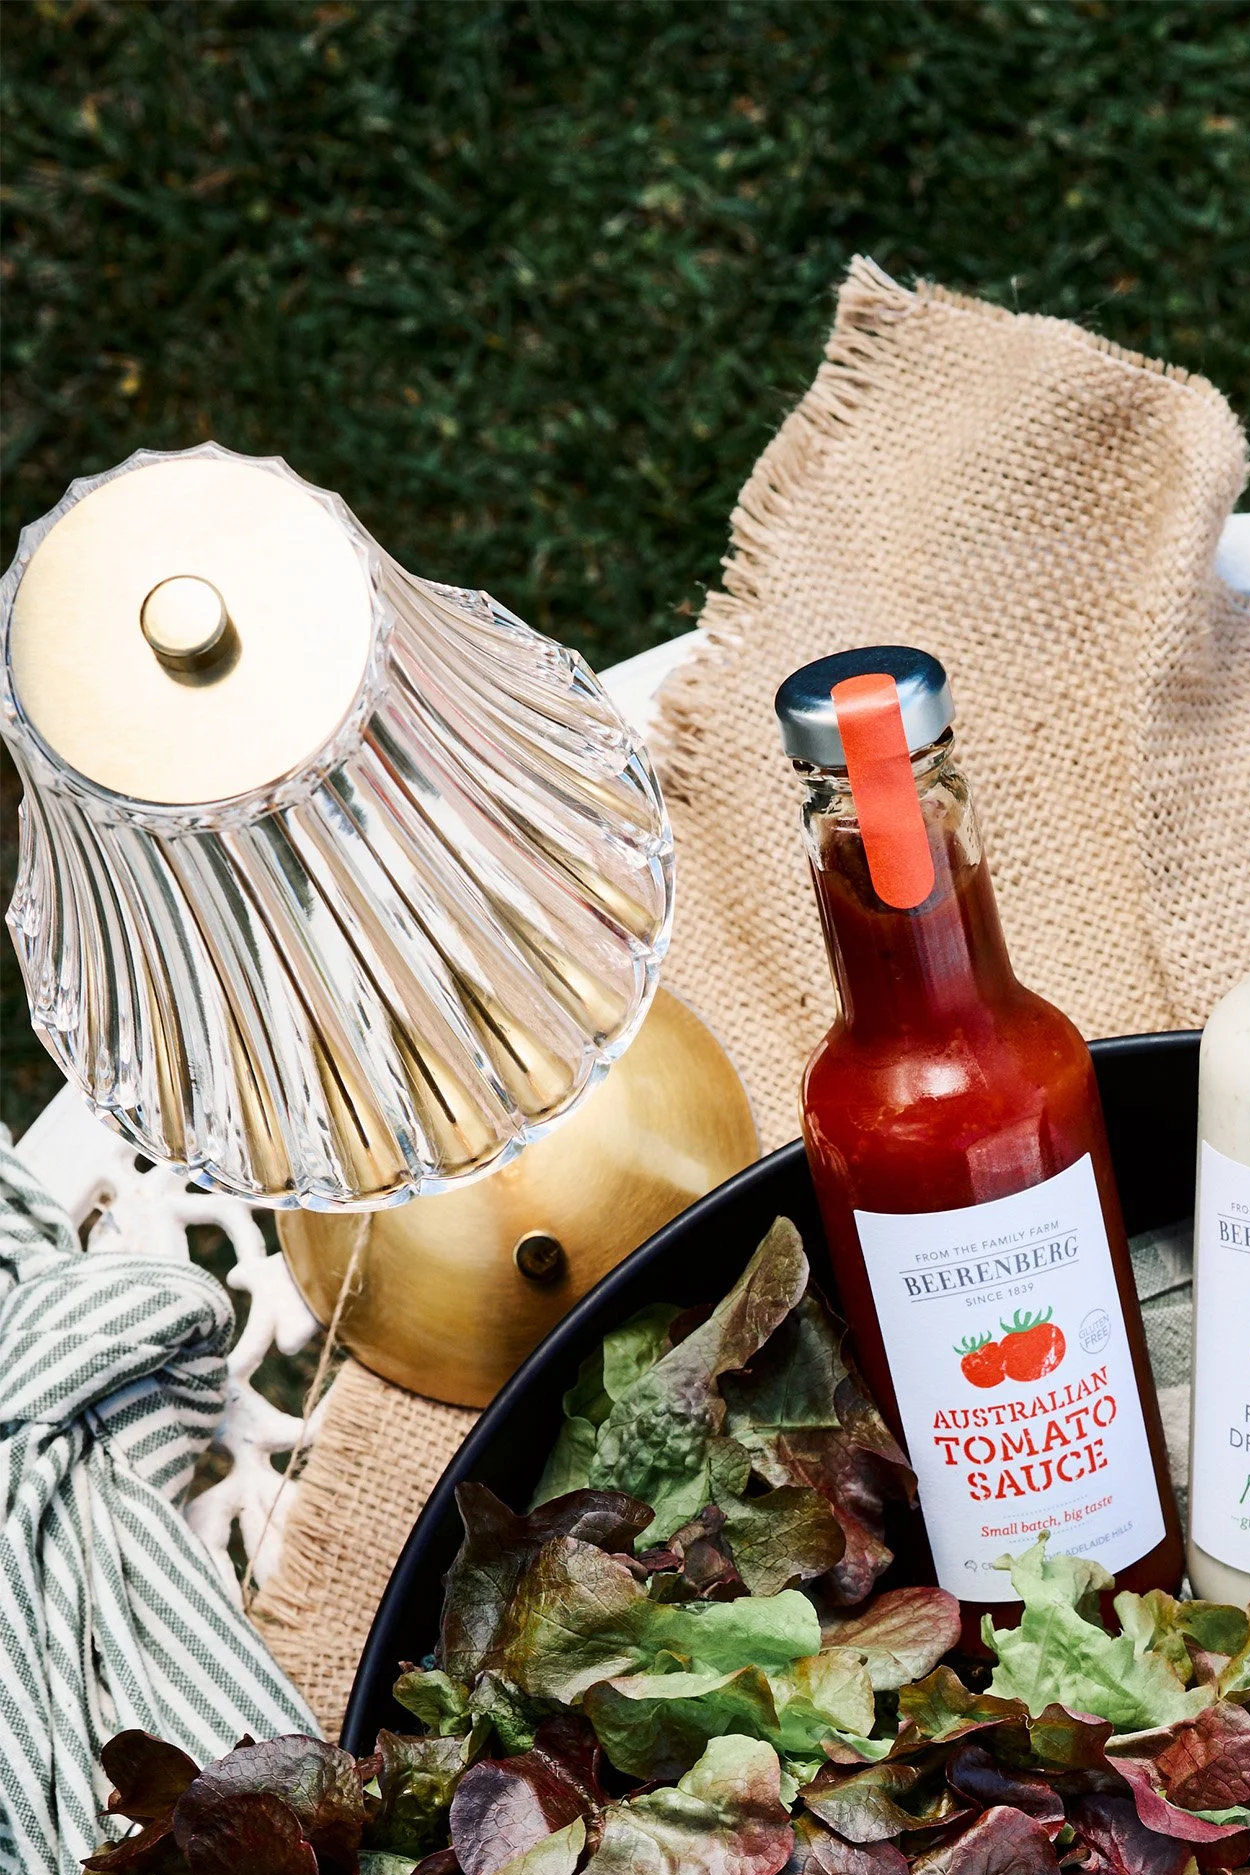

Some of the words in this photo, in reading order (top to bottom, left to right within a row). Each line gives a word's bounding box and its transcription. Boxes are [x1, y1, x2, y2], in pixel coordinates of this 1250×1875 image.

[915, 1249, 950, 1263] FROM
[953, 1243, 978, 1256] THE
[982, 1231, 1025, 1250] FAMILY
[1030, 1220, 1059, 1237] FARM
[902, 1236, 1079, 1297] BEERENBERG
[965, 1291, 1003, 1307] SINCE
[1008, 1282, 1034, 1297] 1839
[1079, 1315, 1110, 1338] GLUTEN
[1085, 1329, 1109, 1349] FREE
[933, 1366, 1108, 1429] AUSTRALIAN
[934, 1395, 1117, 1465] TOMATO
[967, 1438, 1108, 1501] SAUCE
[981, 1523, 1018, 1537] Small
[1021, 1516, 1061, 1533] batch,
[1063, 1508, 1083, 1523] big
[1085, 1495, 1113, 1514] taste
[1065, 1533, 1111, 1556] ADELAIDE
[1112, 1520, 1133, 1538] HILLS
